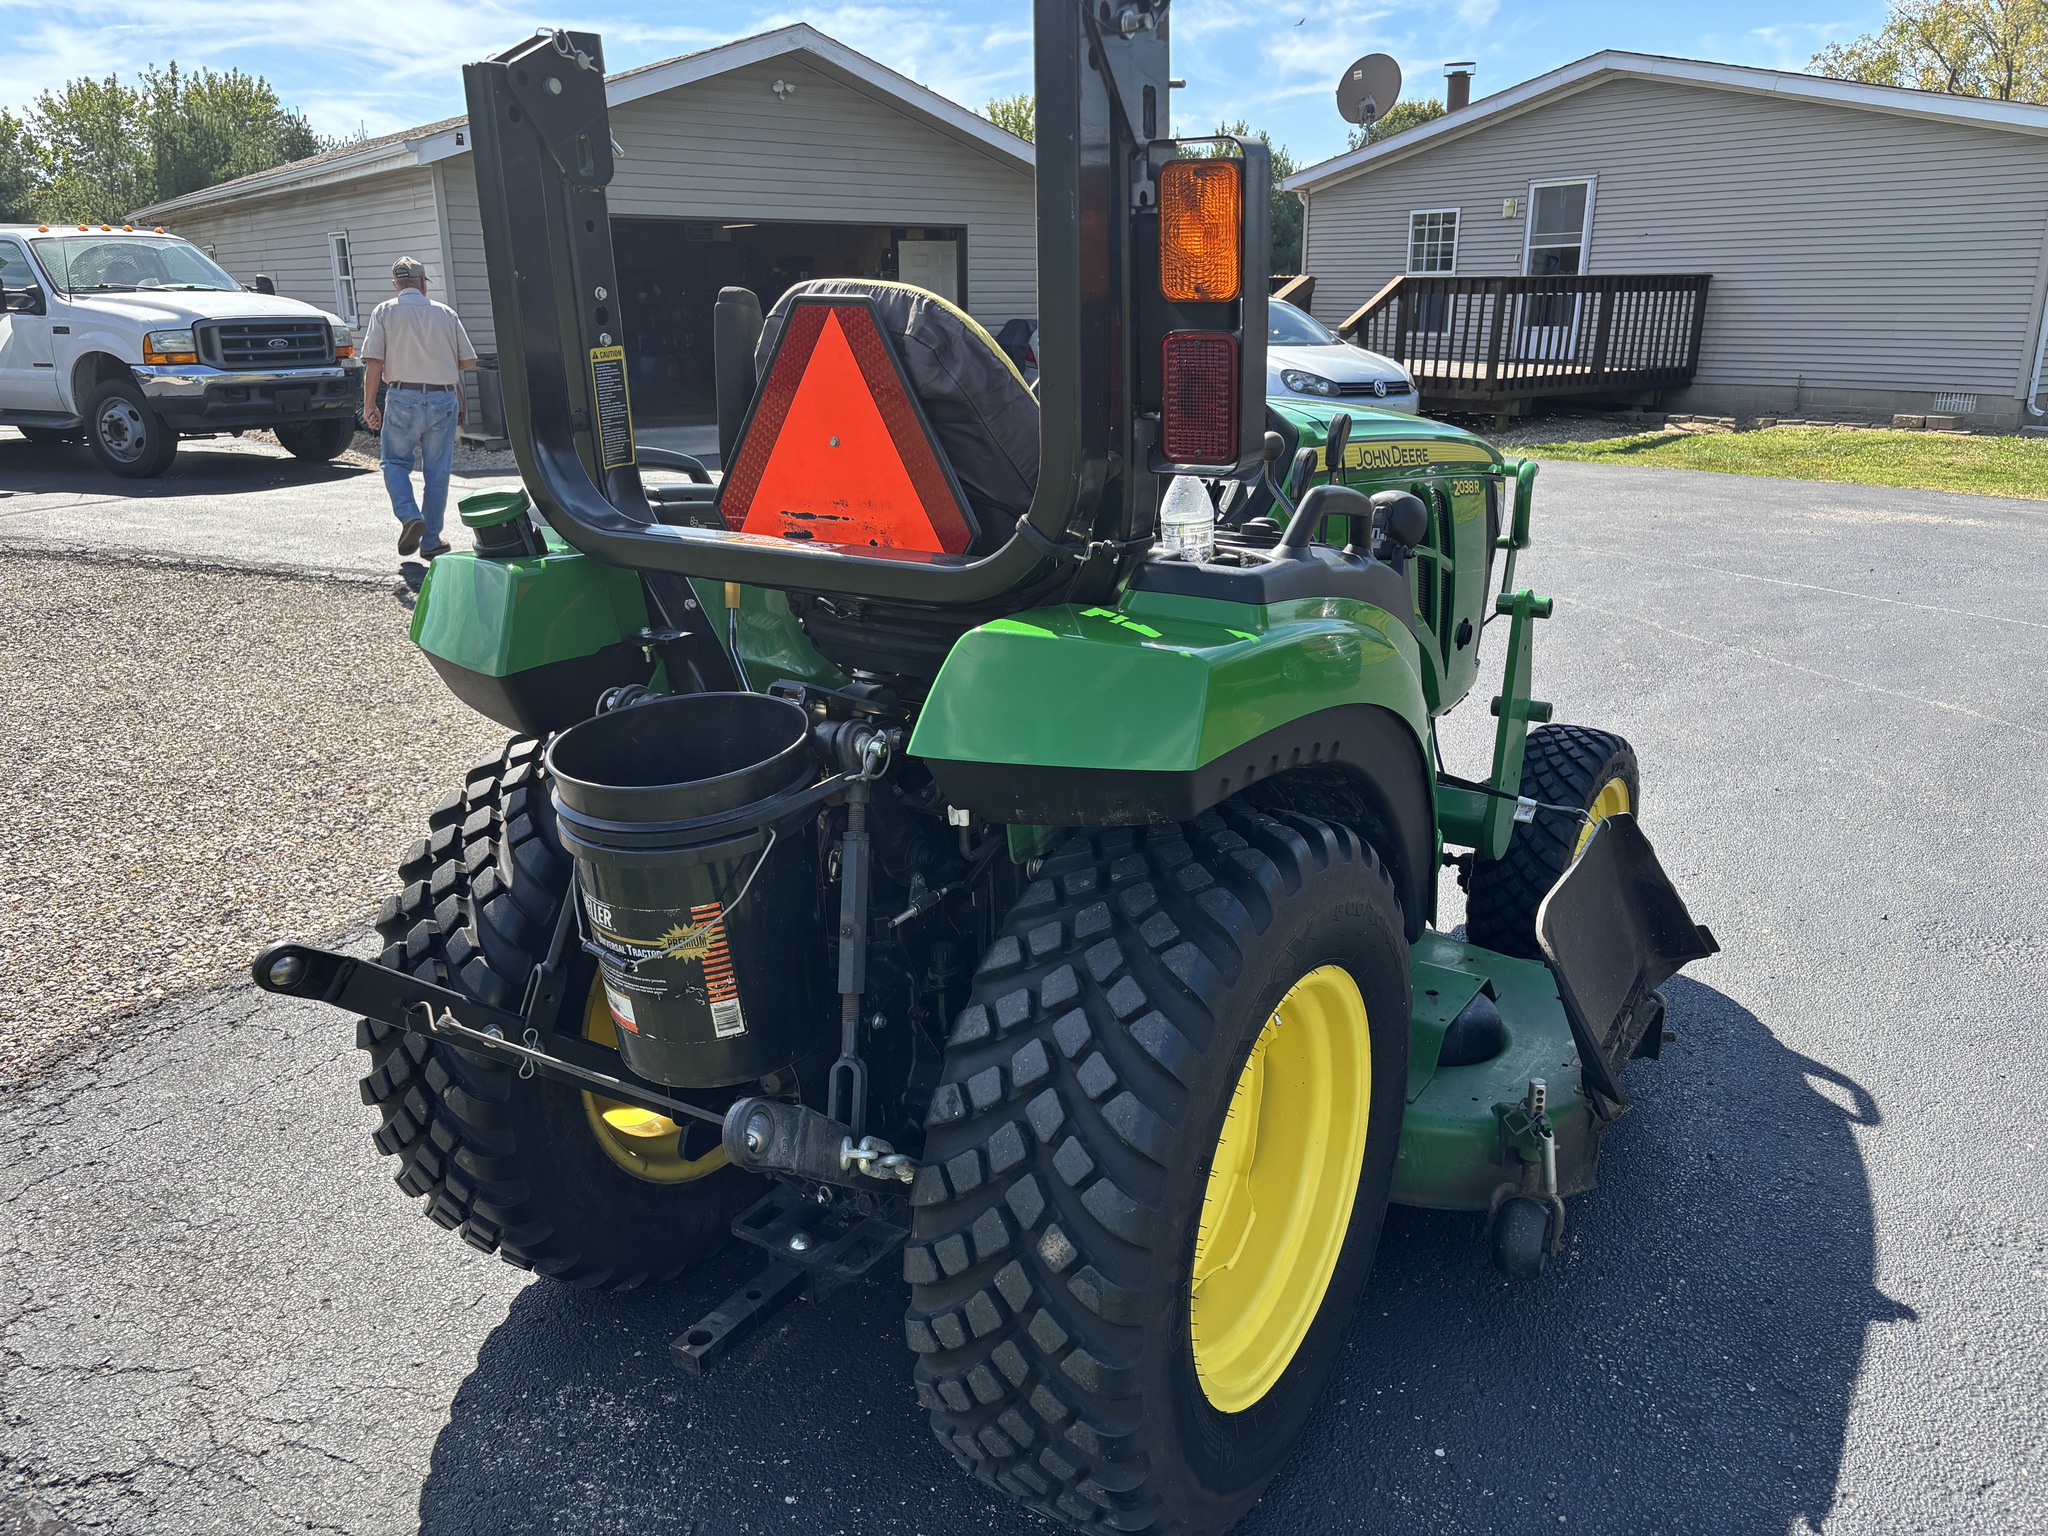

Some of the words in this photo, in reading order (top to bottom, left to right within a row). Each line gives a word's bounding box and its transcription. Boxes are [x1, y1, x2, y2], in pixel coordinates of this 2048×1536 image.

[600, 349, 622, 359] CAUTION
[1356, 446, 1391, 468] JOHN
[1391, 445, 1429, 465] DEERE
[667, 935, 707, 949] PREMIUM
